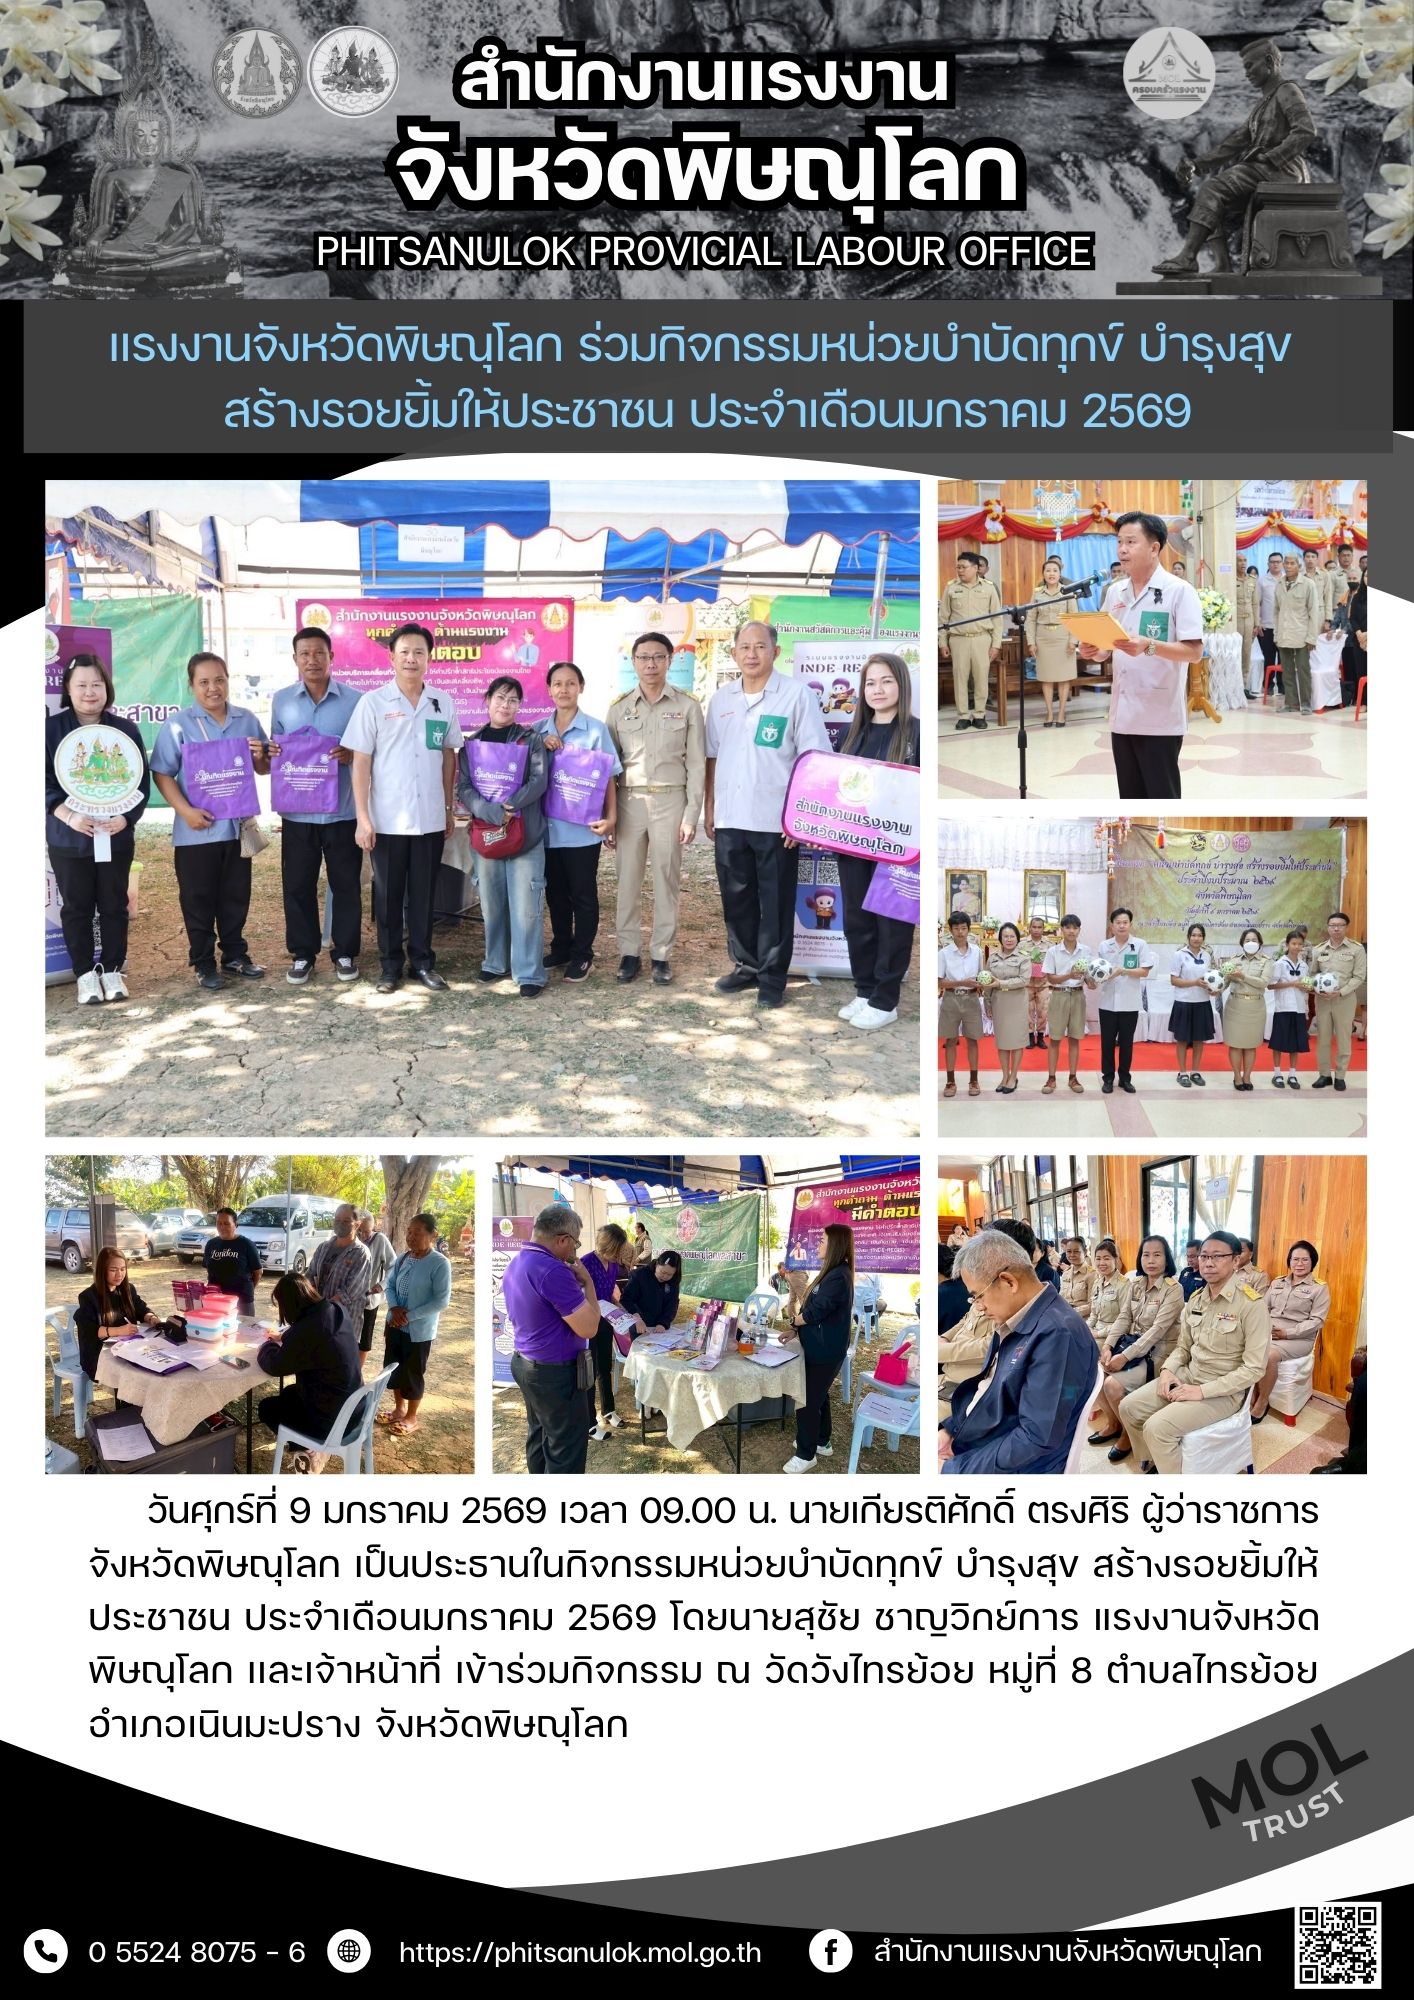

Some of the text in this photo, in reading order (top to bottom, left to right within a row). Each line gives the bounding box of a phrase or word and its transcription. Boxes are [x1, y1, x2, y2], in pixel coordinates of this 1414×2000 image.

[335, 608, 537, 624] สำนักงานแรงงานจังหวัดพิษณุโลก
[795, 797, 912, 836] สำนักงานแรงงาน
[794, 817, 905, 856] จังหวัดพิษณุโลก
[816, 1176, 920, 1199] สำนักงานแรงงานจังหวั
[210, 1248, 239, 1260] London
